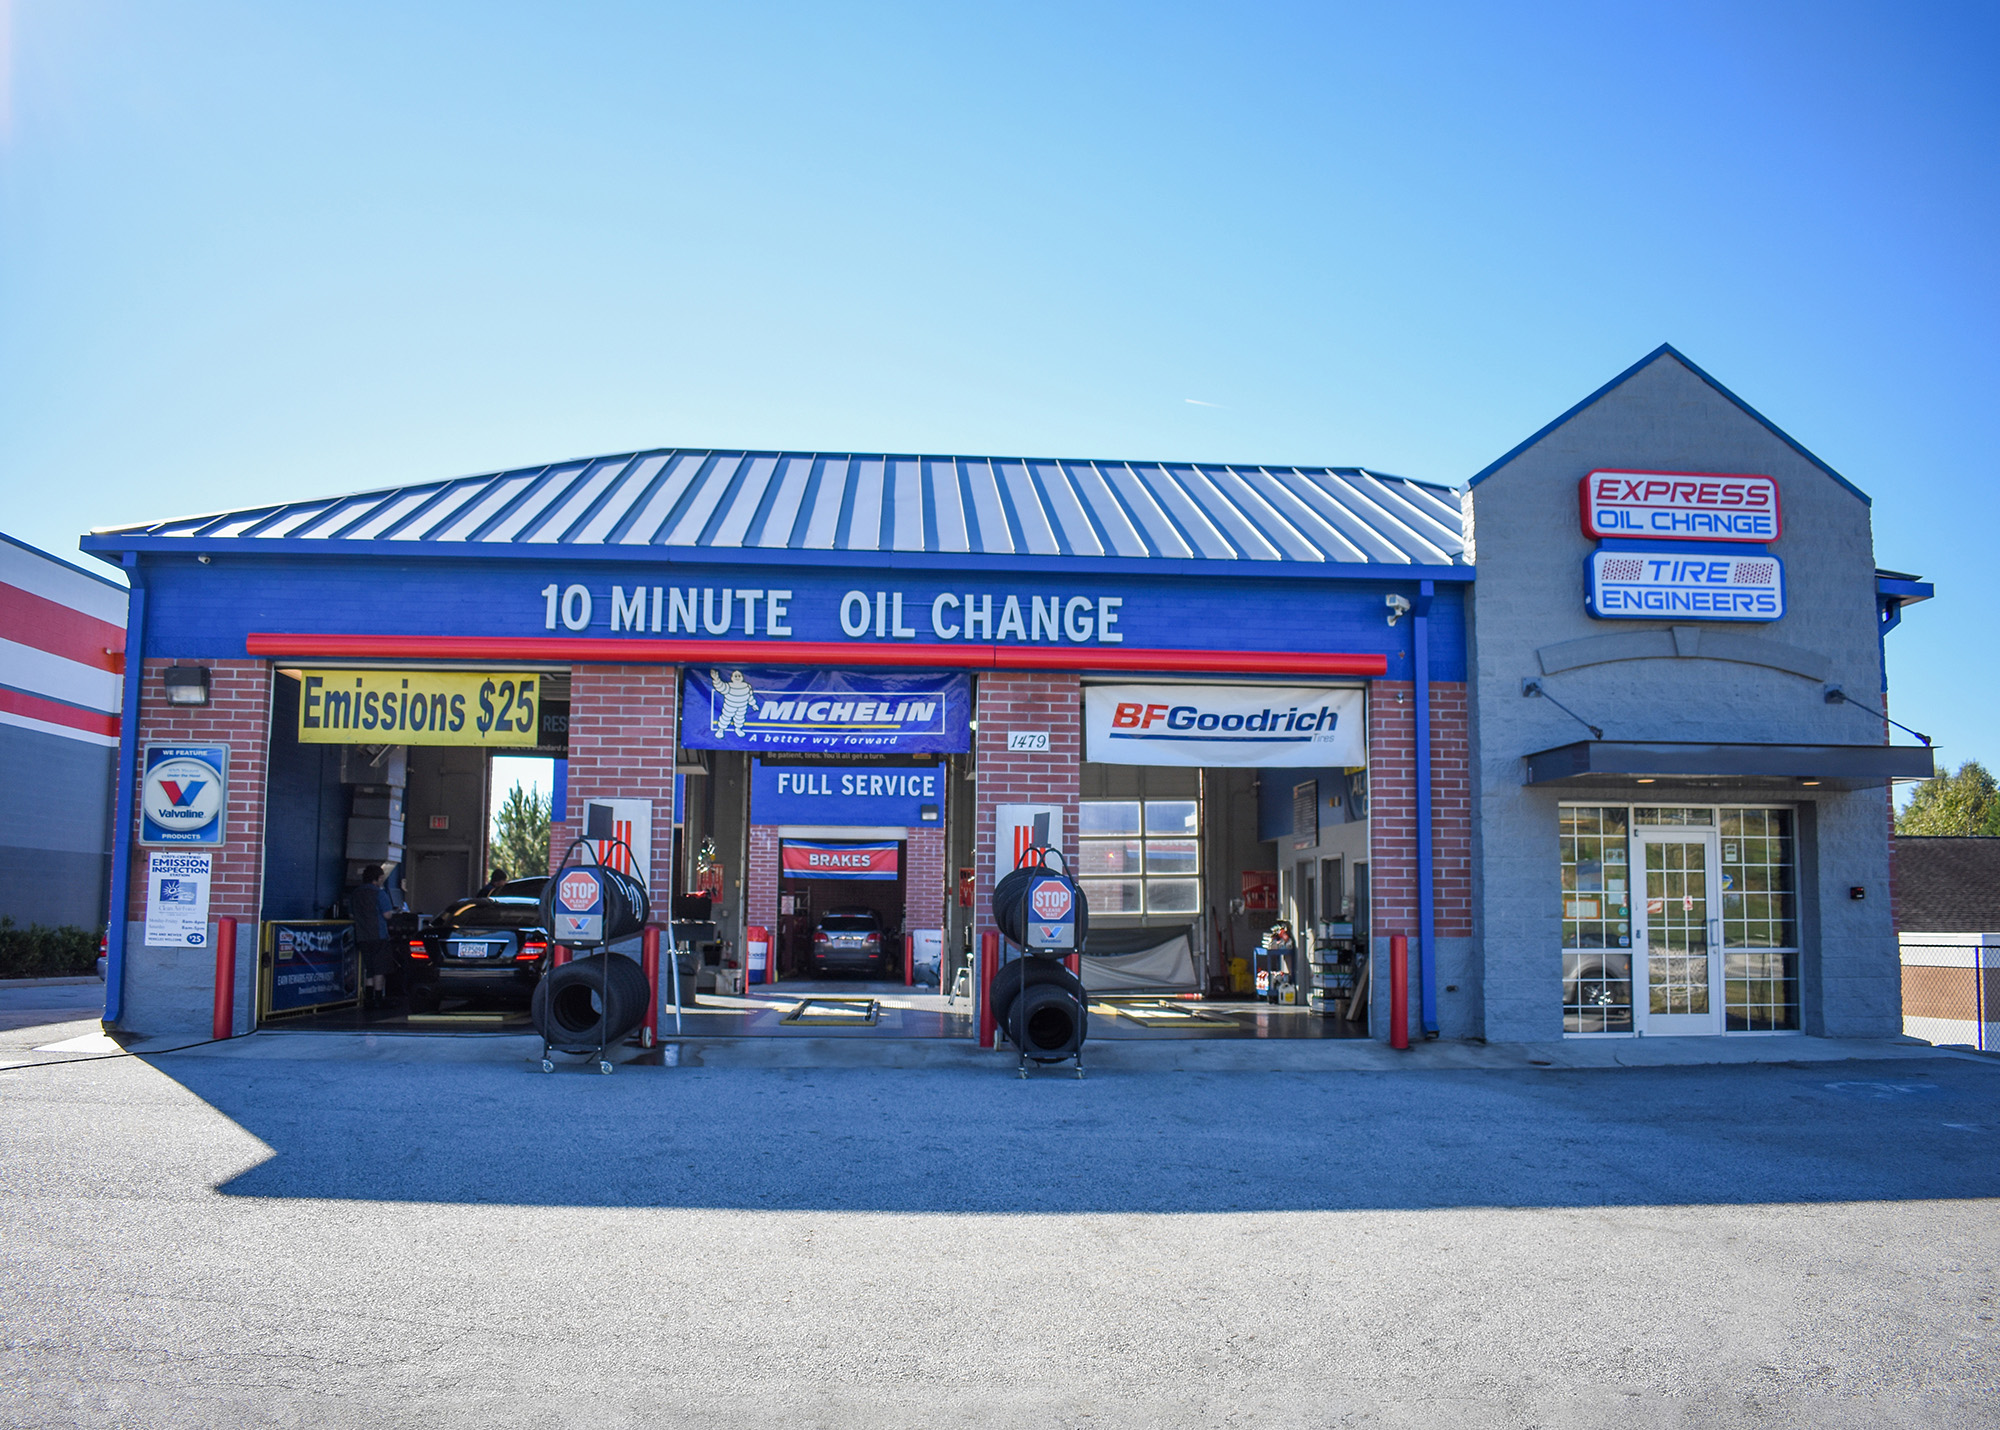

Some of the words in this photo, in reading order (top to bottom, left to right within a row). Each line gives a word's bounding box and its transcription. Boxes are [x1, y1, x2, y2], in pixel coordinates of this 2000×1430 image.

[1596, 479, 1770, 507] EXPRESS
[1597, 510, 1644, 530] OIL
[1651, 512, 1771, 534] CHANGE
[1648, 560, 1730, 583] TIRE
[1602, 590, 1776, 612] ENGINEERS
[541, 583, 592, 631] 10
[610, 585, 792, 636] MINUTE
[839, 590, 915, 638] OIL
[931, 592, 1123, 642] CHANGE
[303, 675, 466, 732] Emissions
[476, 677, 535, 738] $25
[758, 701, 936, 721] MICHELIN
[1111, 702, 1338, 732] BFGoodrich
[749, 734, 758, 742] A
[763, 733, 807, 743] better
[812, 736, 838, 745] way
[844, 735, 899, 745] forward
[1010, 734, 1047, 749] 1479
[1312, 733, 1335, 743] Tires
[851, 752, 863, 761] get
[778, 773, 832, 795] FULL
[841, 775, 935, 797] SERVICE
[158, 809, 204, 818] Valvoline
[432, 816, 448, 828] EXIT
[152, 858, 209, 867] EMISSION
[809, 854, 871, 867] BRAKES
[152, 866, 209, 874] INSPECTION
[562, 882, 597, 899] STOP
[1035, 891, 1068, 908] STOP
